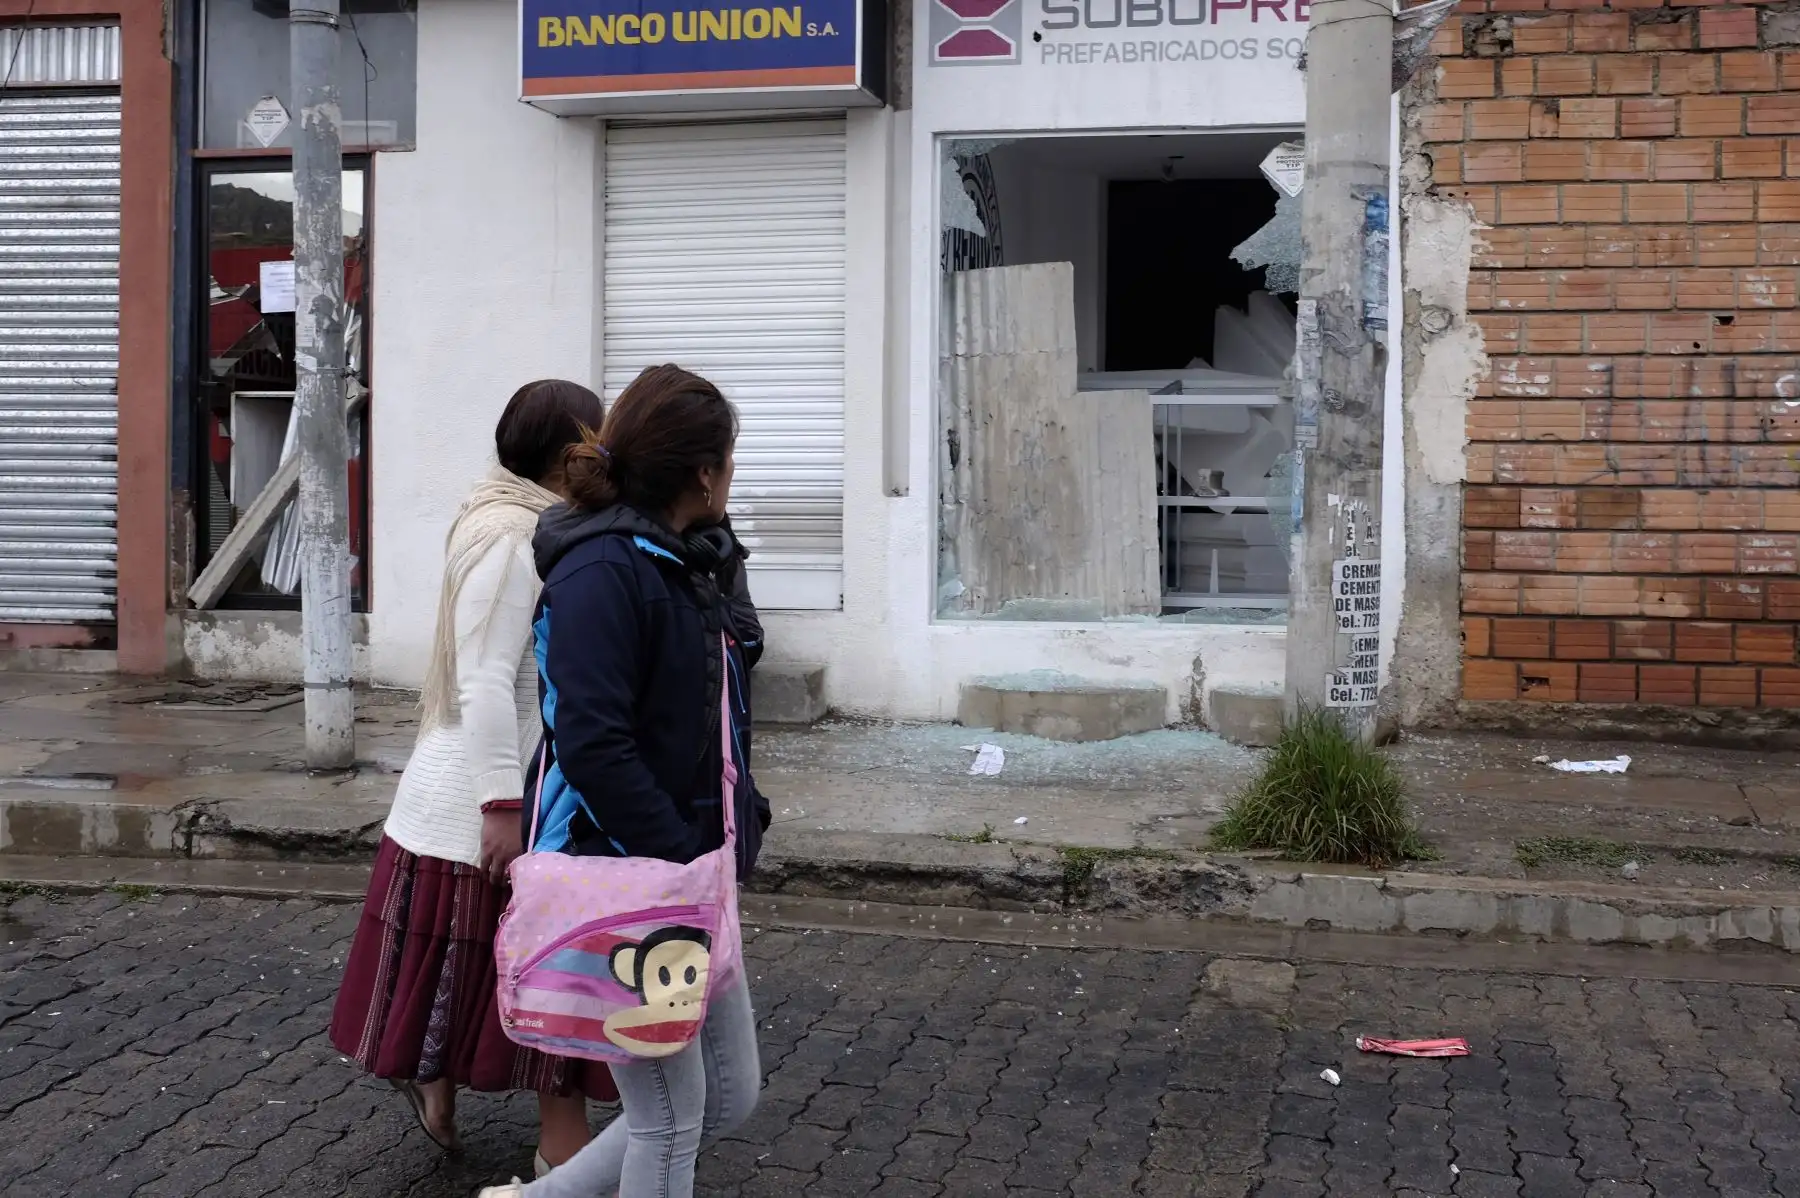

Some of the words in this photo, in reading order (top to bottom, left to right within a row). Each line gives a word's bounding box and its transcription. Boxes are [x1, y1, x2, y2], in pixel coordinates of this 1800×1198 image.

[538, 14, 665, 48] BANCO
[672, 6, 801, 42] UNION
[806, 22, 839, 37] S.A.
[1041, 38, 1258, 65] PREFABRICADOS
[1340, 580, 1380, 595] CEMENT
[1335, 598, 1351, 611] DE
[1330, 687, 1358, 702] Cel.:
